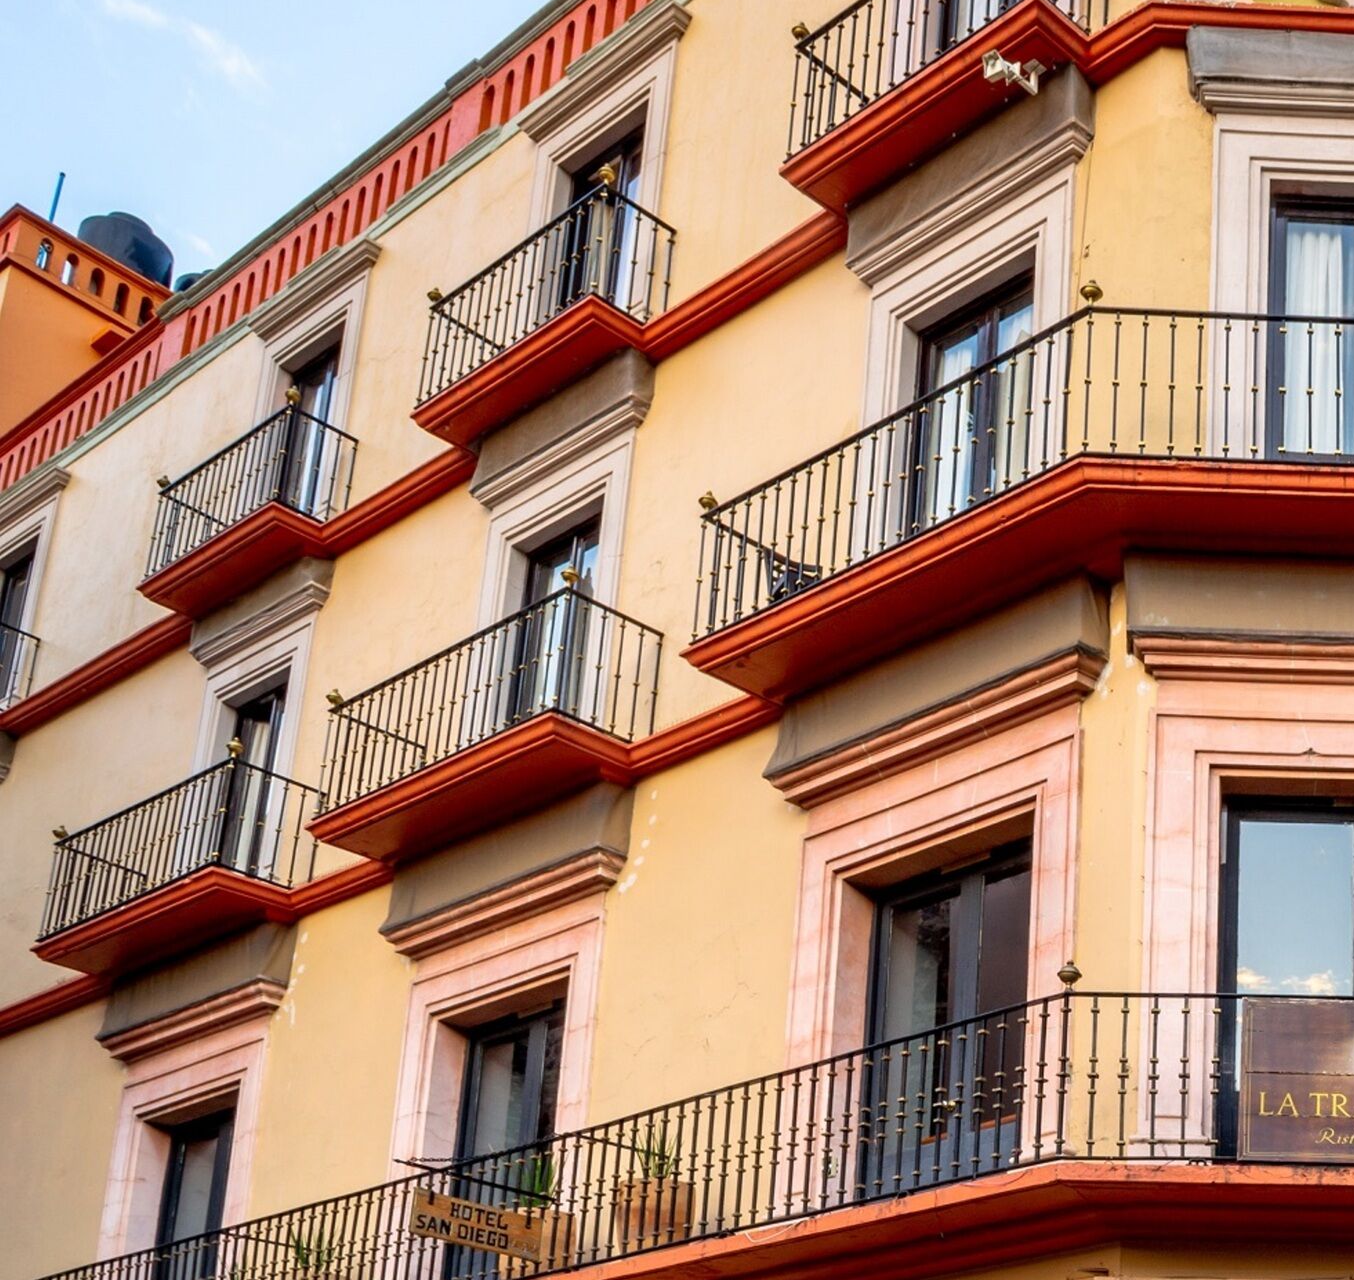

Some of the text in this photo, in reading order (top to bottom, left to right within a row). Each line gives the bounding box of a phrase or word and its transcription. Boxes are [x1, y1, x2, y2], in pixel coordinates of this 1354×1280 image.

[1258, 1091, 1300, 1118] LA
[450, 1202, 508, 1231] HOTEL
[415, 1213, 509, 1250] SAN DIEGO
